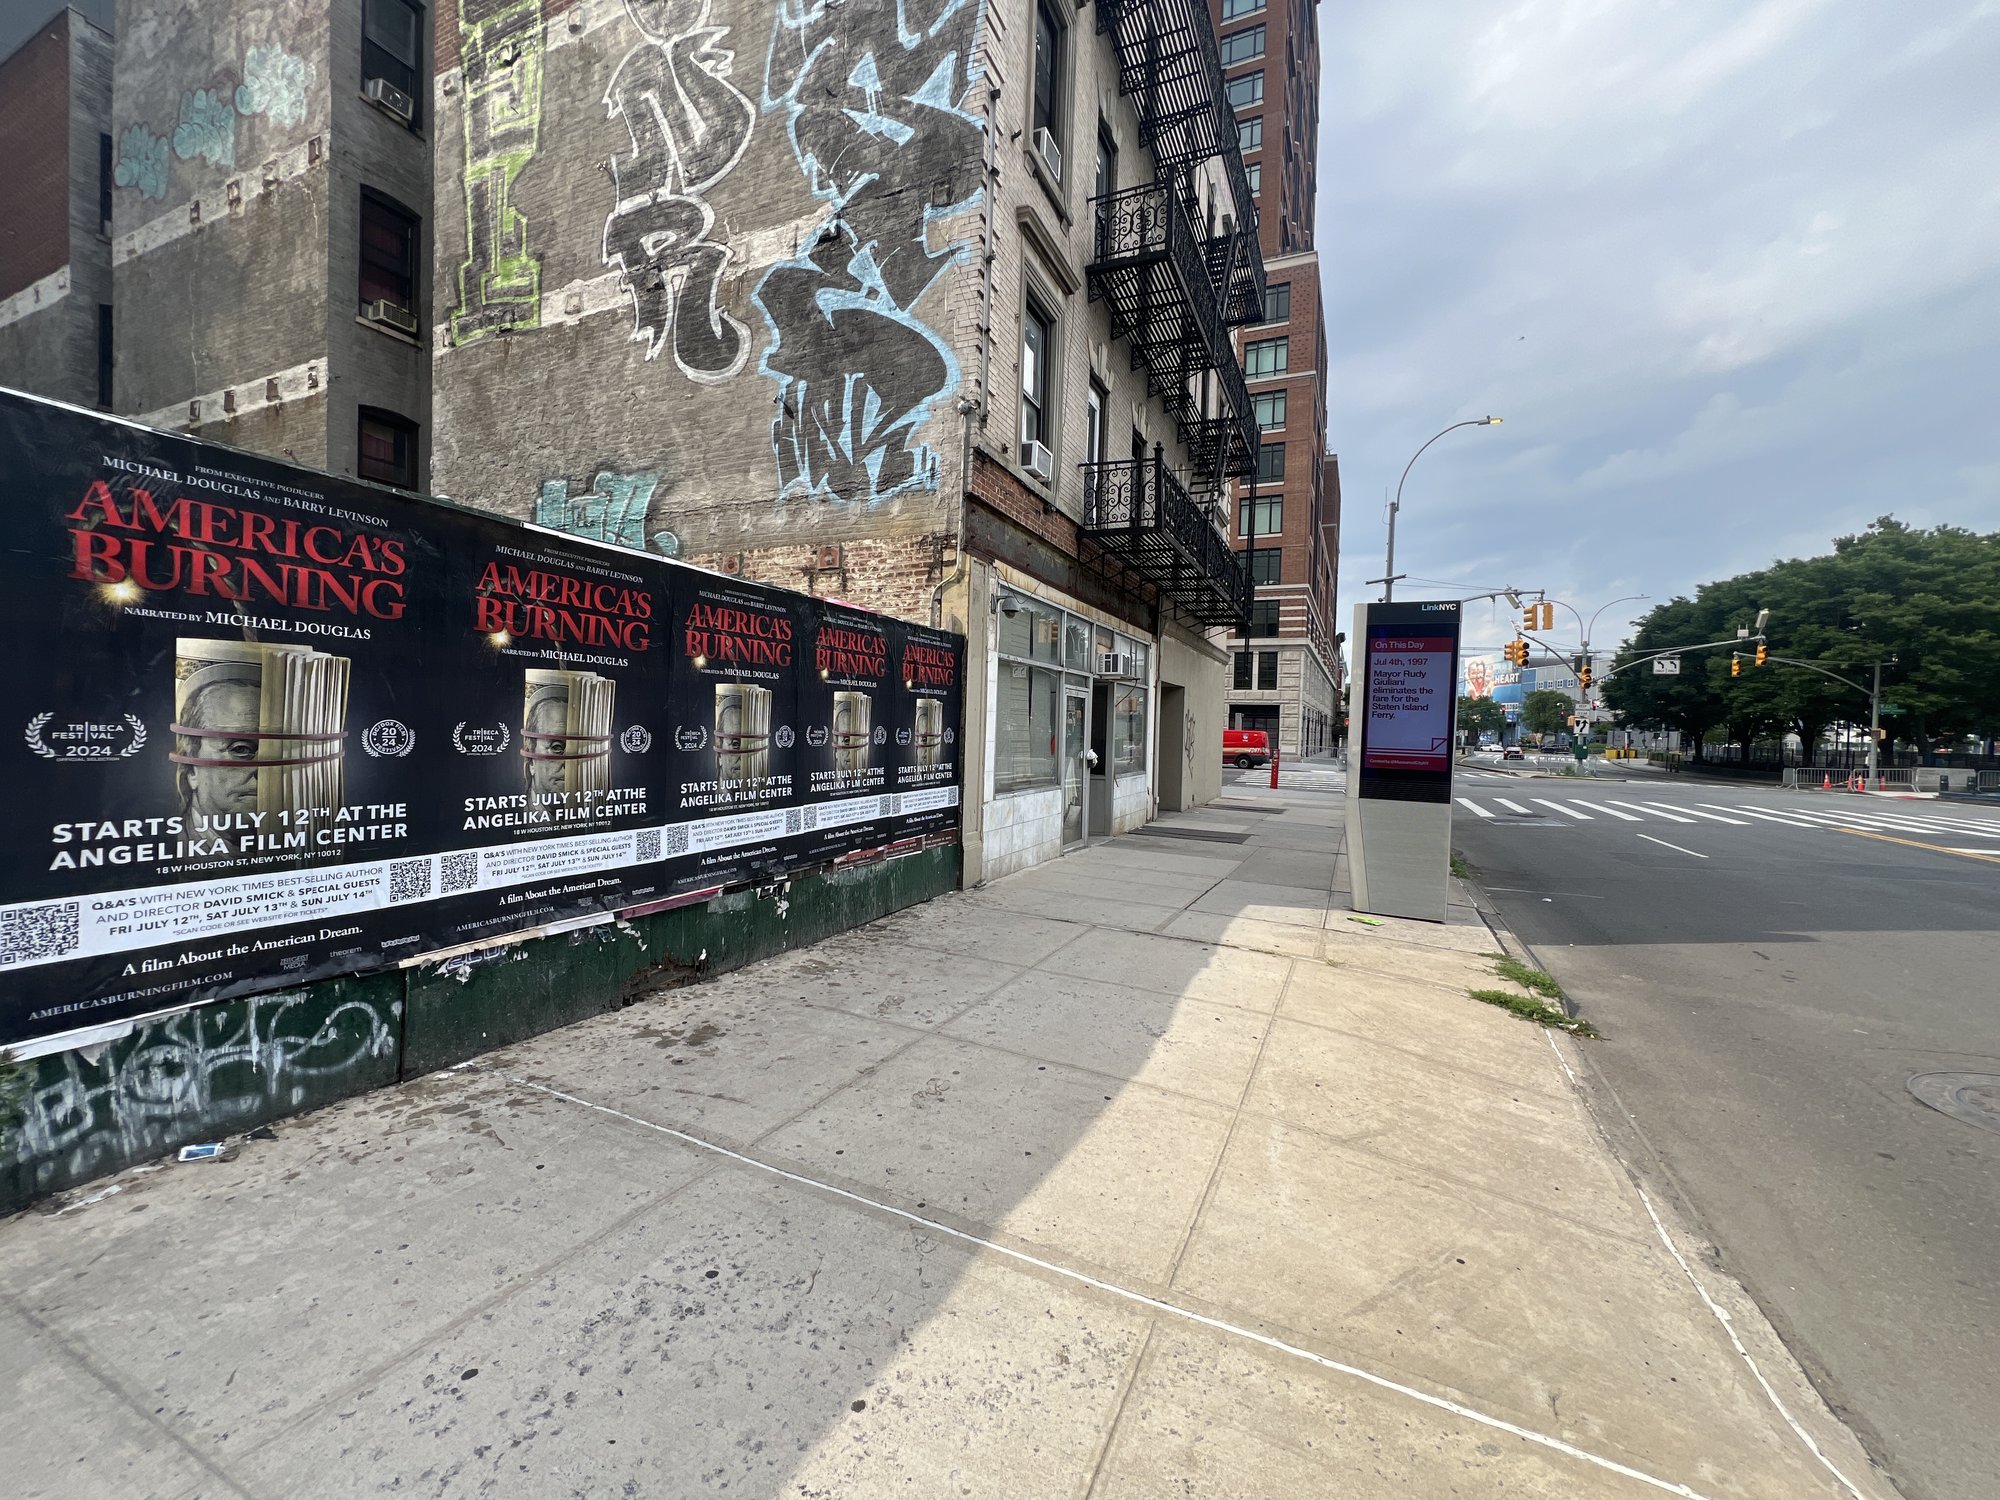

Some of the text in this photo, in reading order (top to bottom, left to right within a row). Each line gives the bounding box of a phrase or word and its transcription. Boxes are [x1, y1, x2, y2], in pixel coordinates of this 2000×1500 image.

[102, 456, 389, 528] MICHAEL DOUGLAS AND BARRY LEVINSON
[195, 465, 324, 500] FROM EXECUTIVE PRODUCERS
[65, 480, 406, 576] AMERICA'S
[495, 545, 536, 561] MICHAEL
[537, 554, 575, 569] DOUGLAS
[586, 565, 610, 577] BARRY
[67, 528, 407, 621] BURNING
[475, 561, 653, 619] AMERICA'S
[721, 594, 744, 605] DOUGLAS
[1422, 603, 1457, 611] LinkNYC
[124, 606, 371, 640] NARRATED BY MICHAEL DOUGLAS
[473, 596, 650, 651] BURNING
[685, 602, 793, 641] AMERICA'S
[685, 629, 792, 667] BURNING
[816, 626, 887, 656] AMERICA'S
[1375, 641, 1425, 650] On This Day
[501, 648, 532, 658] NARRATED
[540, 649, 585, 663] MICHAEL
[586, 654, 628, 667] DOUGLAS
[815, 648, 886, 678] BURNING
[903, 644, 955, 668] AMERICA'S
[1374, 658, 1428, 667] Jul 4th, 1997
[724, 668, 752, 678] MICHAEL
[753, 670, 780, 680] DOUGLAS
[902, 662, 954, 686] BURNING
[1373, 678, 1405, 686] Giuliani
[1374, 670, 1427, 680] Mayor Rudy
[1494, 673, 1520, 683] HEART
[1372, 695, 1420, 703] fare for the
[1373, 686, 1434, 695] eliminates the
[1371, 711, 1396, 720] Ferry.
[1372, 702, 1429, 711] Staten Island
[382, 727, 397, 736] 20
[66, 745, 112, 757] 2024
[382, 738, 396, 747] 24
[471, 744, 493, 753] 2024
[810, 770, 836, 781] STARTS
[837, 769, 852, 779] JULY
[875, 767, 885, 776] THE
[897, 774, 923, 785] ANGELIKA
[934, 771, 953, 780] CENTER
[898, 765, 917, 775] STARTS
[680, 780, 718, 794] STARTS
[720, 778, 743, 790] JULY
[766, 776, 777, 786] AT
[777, 774, 793, 785] THE
[810, 781, 846, 793] ANGELIKA
[862, 777, 885, 787] CENTER
[464, 787, 647, 812] STARTS JULY 12TH AT THE
[680, 793, 733, 808] ANGELIKA
[734, 789, 757, 802] FILM
[759, 787, 793, 799] CENTER
[52, 803, 407, 844] STARTS JULY 12TH AT THE
[463, 802, 647, 831] ANGELIKA FILM CENTER
[49, 822, 408, 871] ANGELIKA FILM CENTER
[536, 851, 557, 861] DAVID
[558, 849, 579, 857] SMICK
[586, 845, 611, 854] SPECIAL
[611, 842, 632, 851] GUESTS
[156, 867, 169, 875] 18
[171, 865, 182, 873] W
[184, 860, 234, 872] HOUSTON
[236, 858, 249, 867] ST,
[251, 855, 274, 865] NEW
[275, 853, 302, 862] YORK,
[317, 849, 342, 858] 10012
[92, 867, 384, 912] Q&A'S WITH NEW YORK TIMES BEST-SELLING AUTHOR
[499, 877, 623, 906] A film About the American Dream.
[96, 878, 381, 925] AND DIRECTOR DAVID SMICK & SPECIAL GUESTS
[109, 925, 132, 936] FRI
[136, 919, 169, 932] JULY
[206, 910, 229, 922] SAT
[231, 905, 260, 917] JULY
[264, 902, 288, 912] 13TH
[290, 901, 298, 909] &
[301, 898, 323, 908] SUN
[325, 893, 350, 904] JULY
[352, 889, 373, 900] 14TH
[200, 922, 221, 932] CODE
[223, 920, 235, 928] OR
[239, 918, 250, 926] SEE
[251, 913, 282, 924] WEBSITE
[283, 910, 298, 919] FOR
[121, 963, 137, 977] A
[141, 957, 173, 974] film
[176, 949, 223, 967] About
[226, 944, 250, 957] the
[252, 933, 316, 953] American
[319, 926, 363, 941] Dream.
[329, 946, 362, 958] theorem
[283, 961, 306, 971] MEDIA
[28, 971, 233, 1021] AMERICASBURNINGFILM.COM
